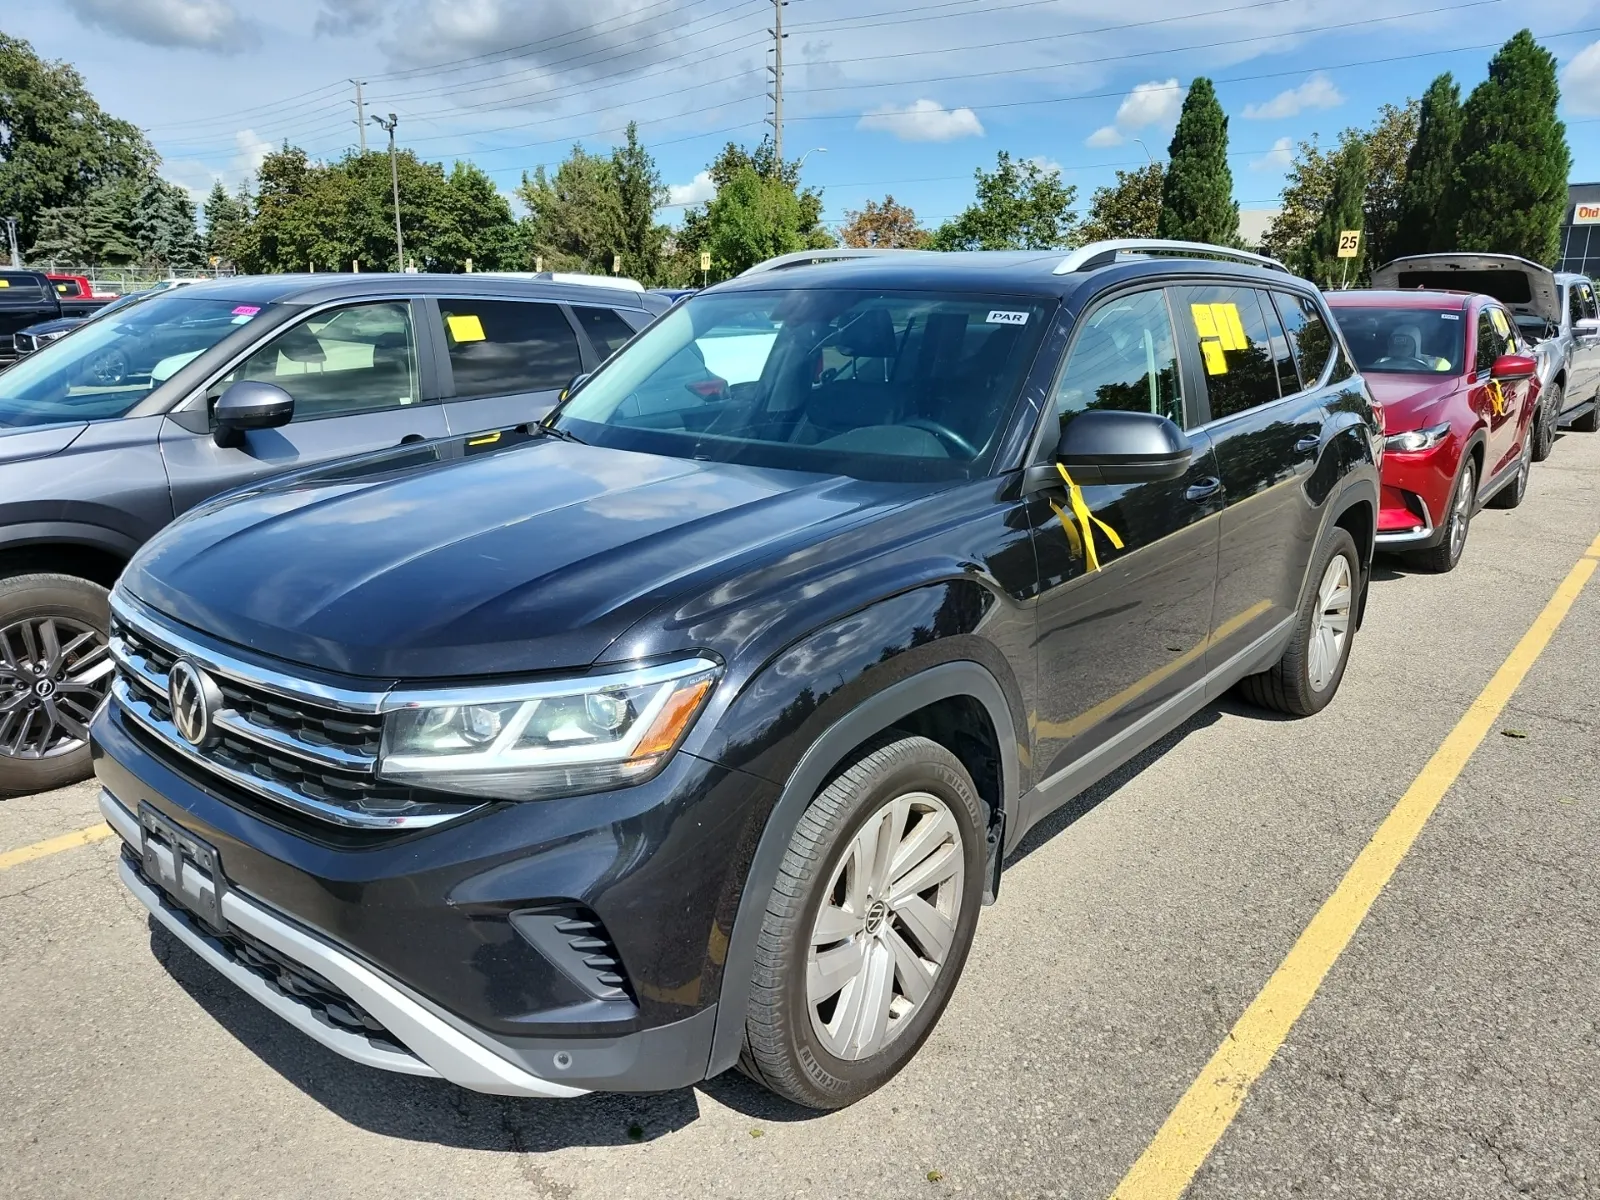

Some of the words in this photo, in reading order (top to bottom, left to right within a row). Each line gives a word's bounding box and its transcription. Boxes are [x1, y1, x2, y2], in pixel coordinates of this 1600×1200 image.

[1579, 206, 1600, 218] Old
[1340, 236, 1357, 249] 25
[992, 313, 1022, 321] PAR
